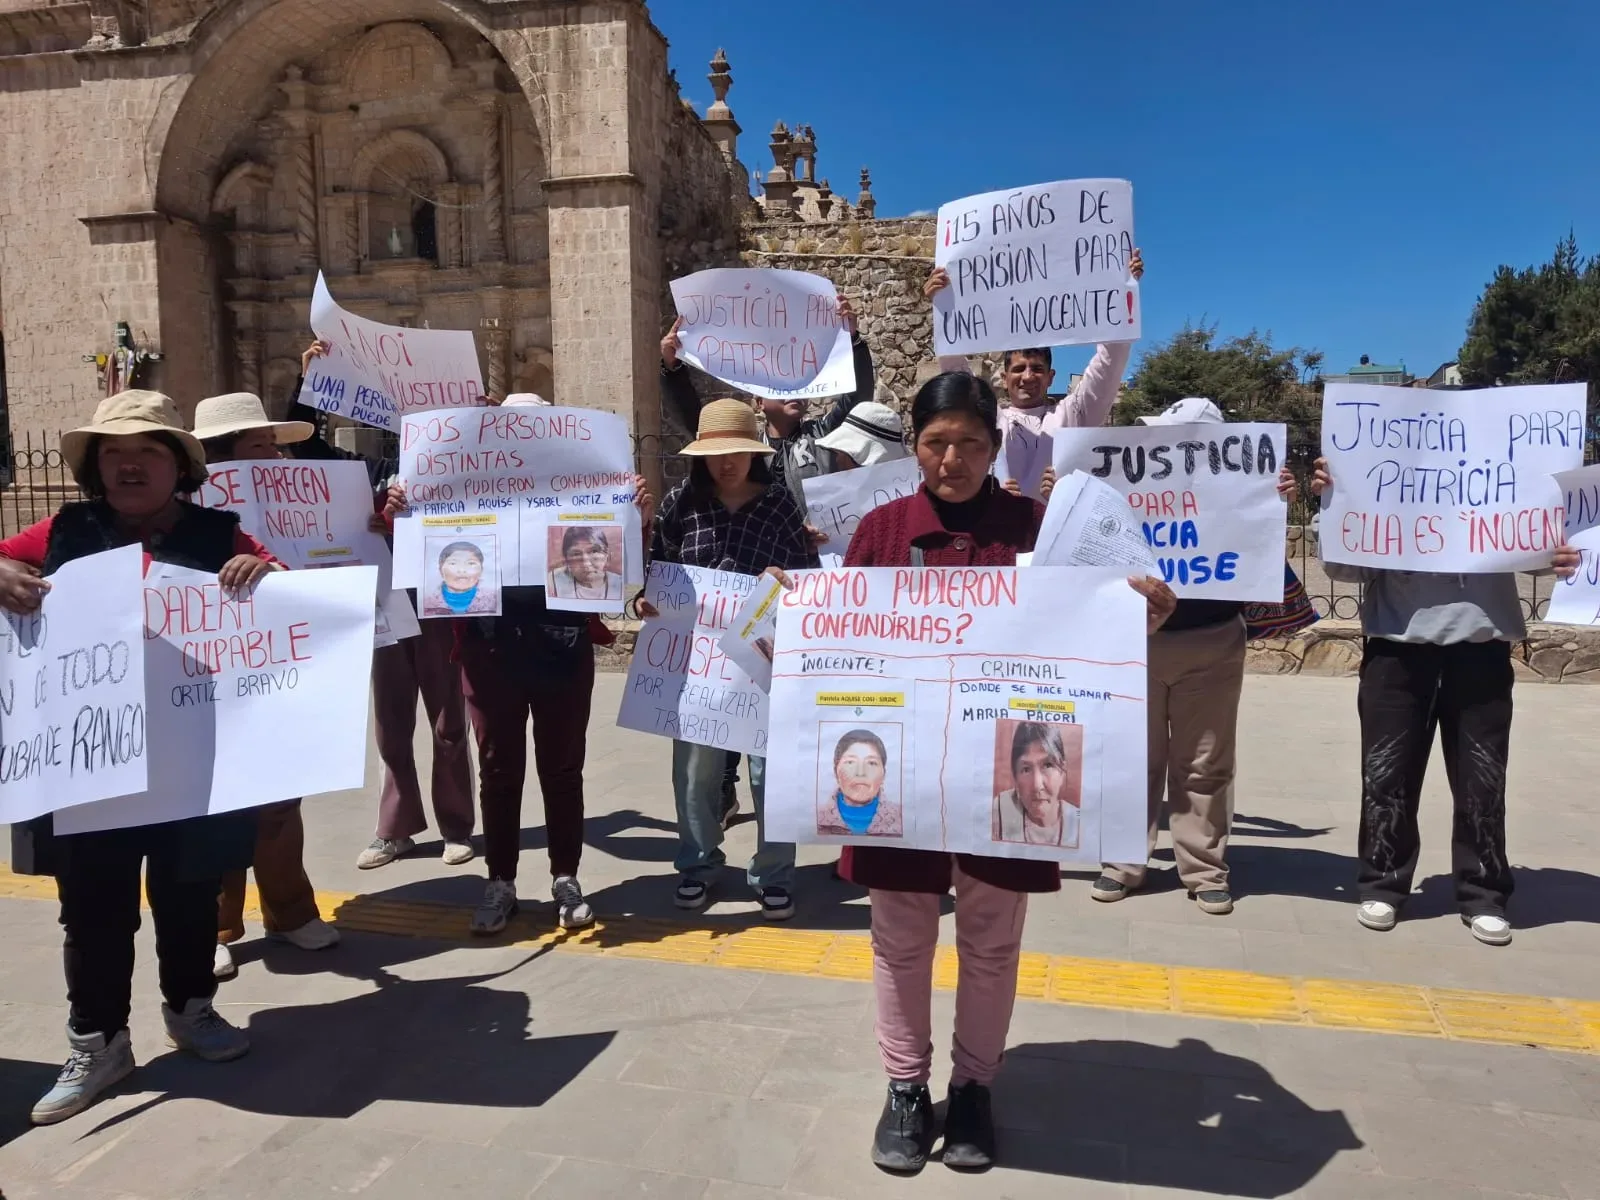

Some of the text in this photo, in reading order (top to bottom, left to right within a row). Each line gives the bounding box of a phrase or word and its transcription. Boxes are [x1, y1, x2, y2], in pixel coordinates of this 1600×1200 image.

[992, 191, 1055, 235] AÑOS
[1079, 190, 1113, 224] DE
[1075, 230, 1134, 276] PARA
[943, 303, 988, 345] UNA
[698, 335, 819, 380] PATRICIA
[312, 372, 345, 399] UNA
[318, 397, 391, 427] NO PUEDE
[402, 411, 592, 450] DOS PERSONAS
[1508, 410, 1583, 462] PARA
[1091, 433, 1276, 484] JUSTICIA
[208, 466, 331, 507] SE PARECEN
[424, 500, 465, 515] PATRICIA
[478, 496, 512, 510] AQUISE
[464, 476, 535, 499] PUDIERON
[526, 492, 636, 508] YSABEL ORTIZ BRAV
[1142, 519, 1199, 550] ICIA
[1342, 511, 1402, 556] ELLA
[1414, 515, 1444, 554] ES
[713, 571, 728, 587] LA
[1158, 551, 1240, 585] UISE
[656, 590, 690, 611] PNP
[783, 570, 867, 610] ¿COMO
[893, 569, 1017, 610] PUDIERON
[144, 584, 254, 641] DADERA
[57, 640, 130, 695] TODO
[183, 622, 312, 677] CULPABLE
[171, 667, 299, 707] ORTIZ BRAVO
[960, 682, 1000, 693] DONDE
[1011, 684, 1027, 694] SE
[1037, 686, 1063, 695] HACE
[981, 660, 1067, 680] CRIMINAL
[634, 673, 760, 720] POR REALIZAR
[962, 708, 1076, 723] MARIA PACORI
[0, 702, 144, 784] UBIR DE RANGO
[655, 707, 730, 746] TRABAJO
